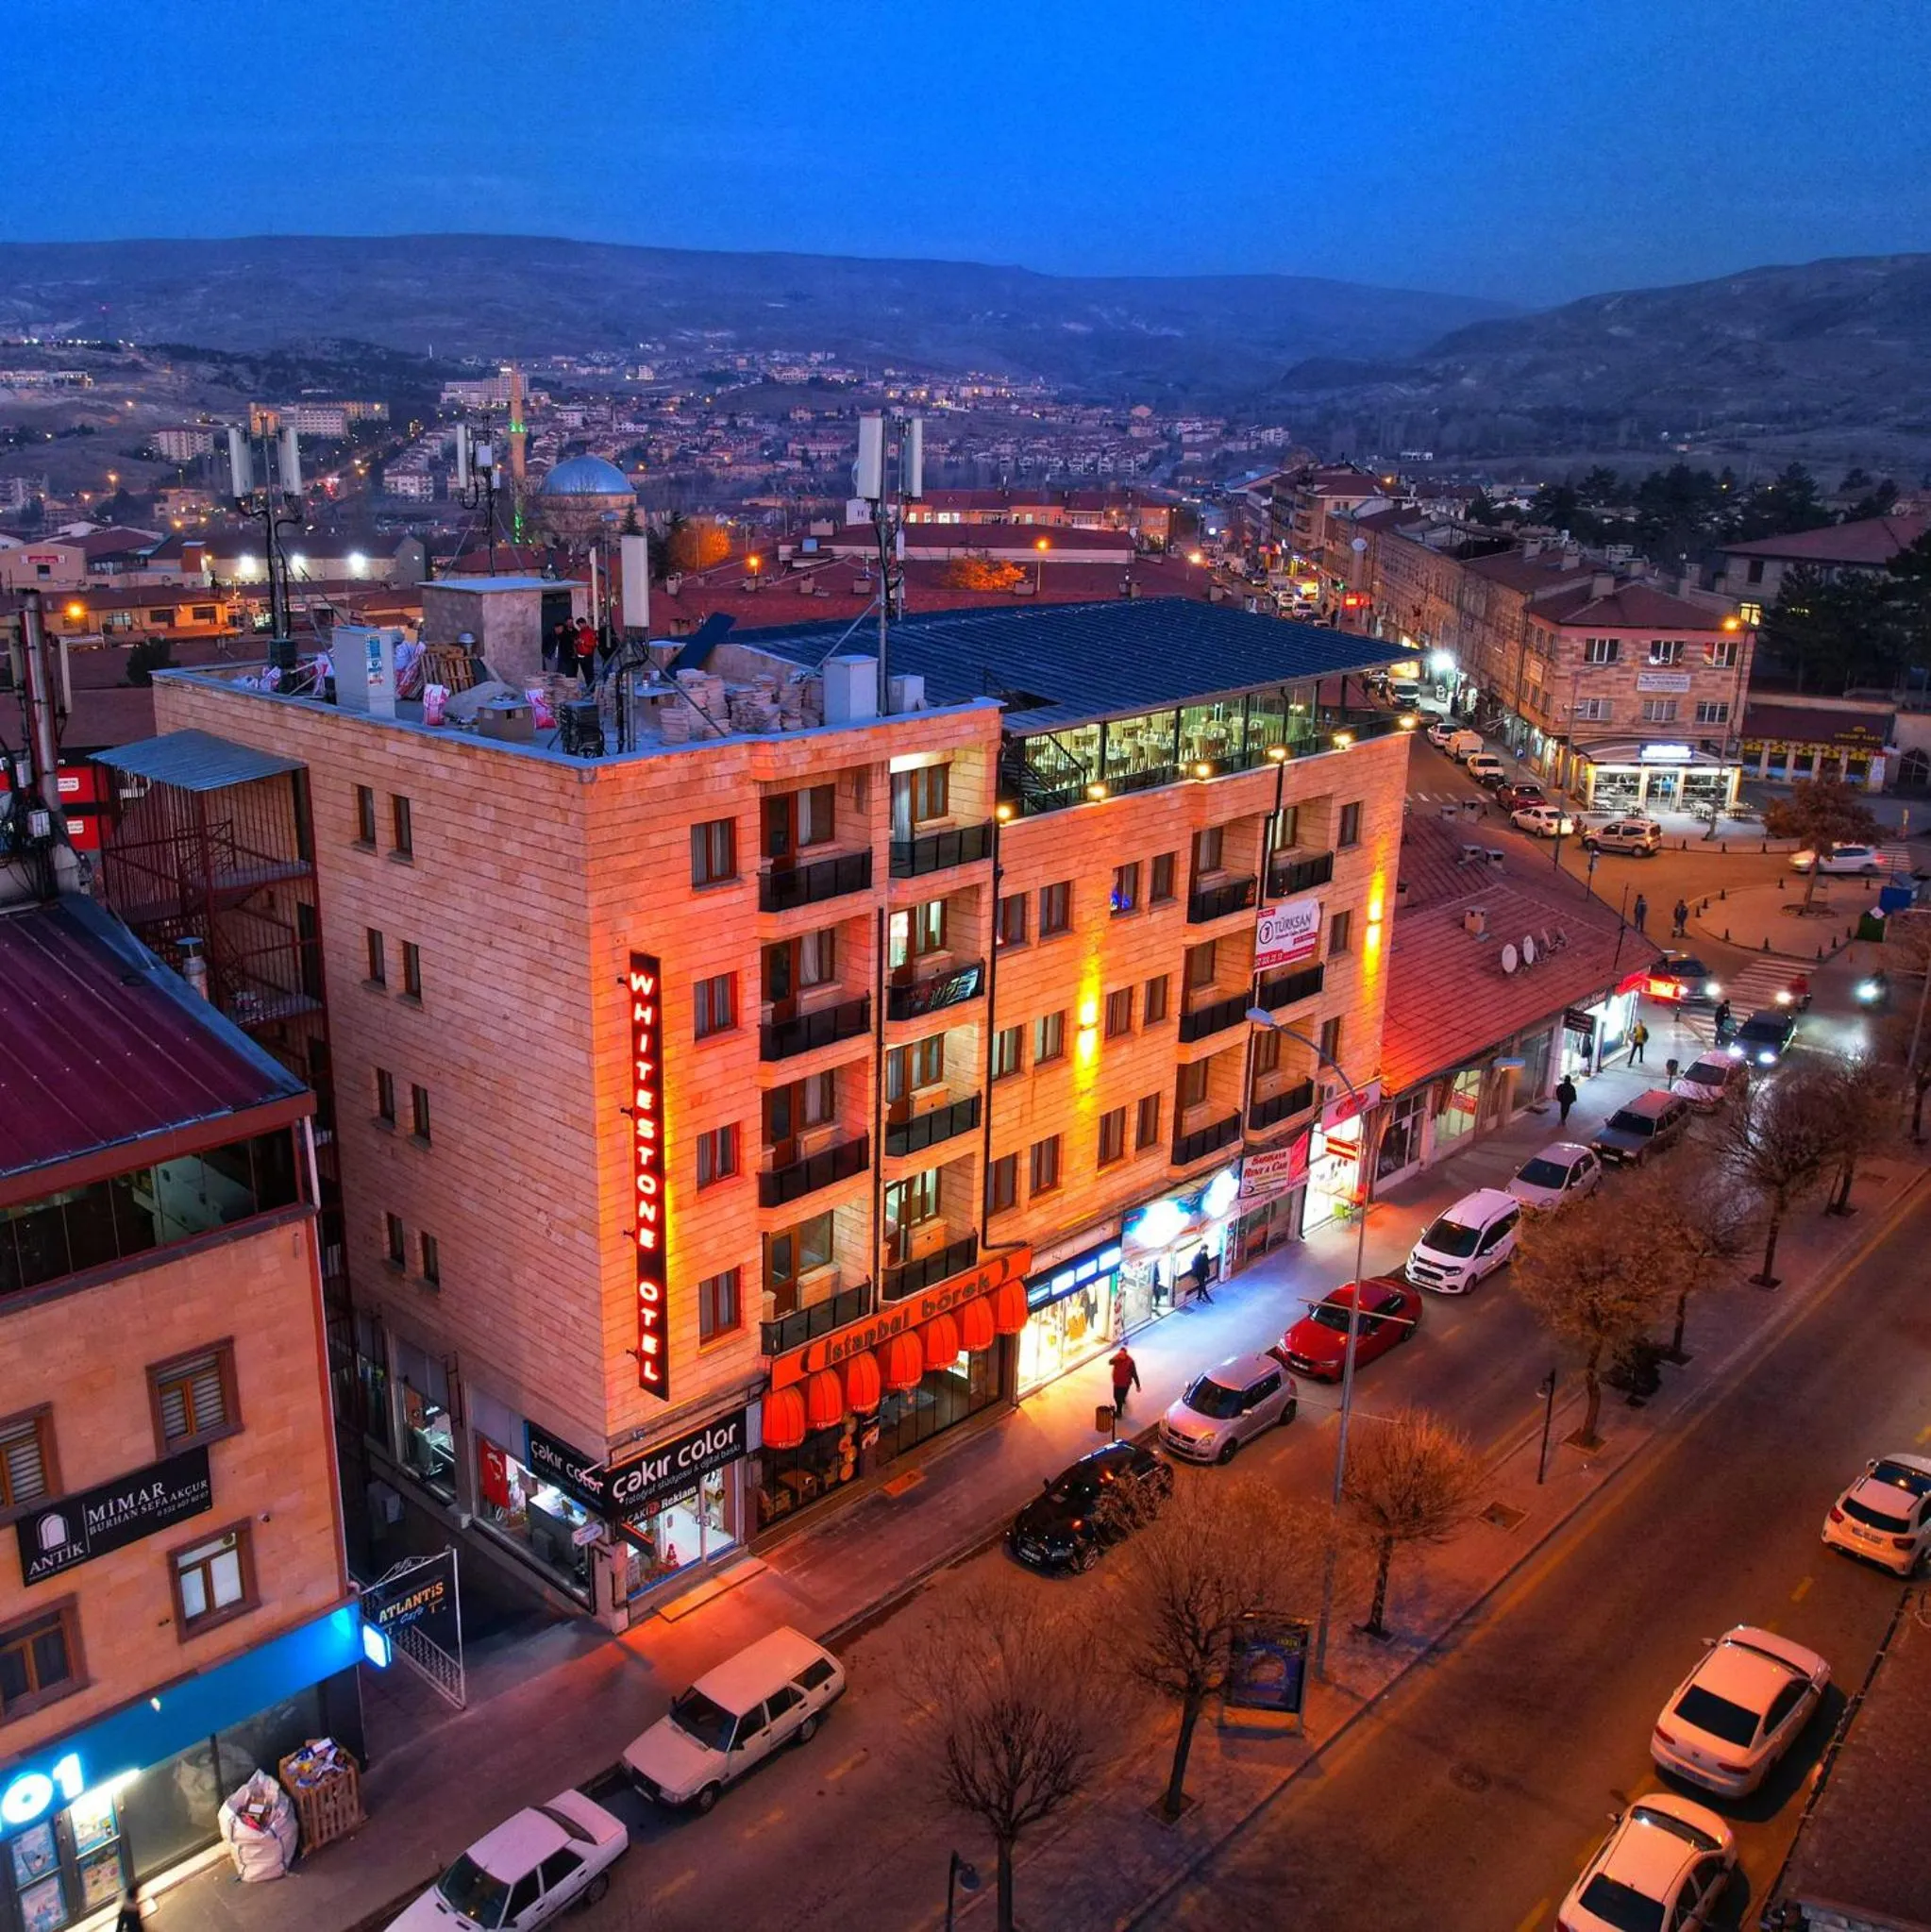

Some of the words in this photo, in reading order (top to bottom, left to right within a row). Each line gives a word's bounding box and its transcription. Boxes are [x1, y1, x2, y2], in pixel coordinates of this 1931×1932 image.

[630, 972, 656, 1249] WHITESTONE
[922, 1271, 990, 1319] börek
[638, 1281, 659, 1381] OTEL
[678, 1423, 736, 1468] color
[88, 1481, 166, 1526] MİMAR
[89, 1508, 139, 1537] BURHAN
[141, 1498, 169, 1515] SEFA
[661, 1486, 697, 1509] Reklam
[28, 1541, 85, 1575] ANTİK
[0, 1752, 84, 1826] 01
